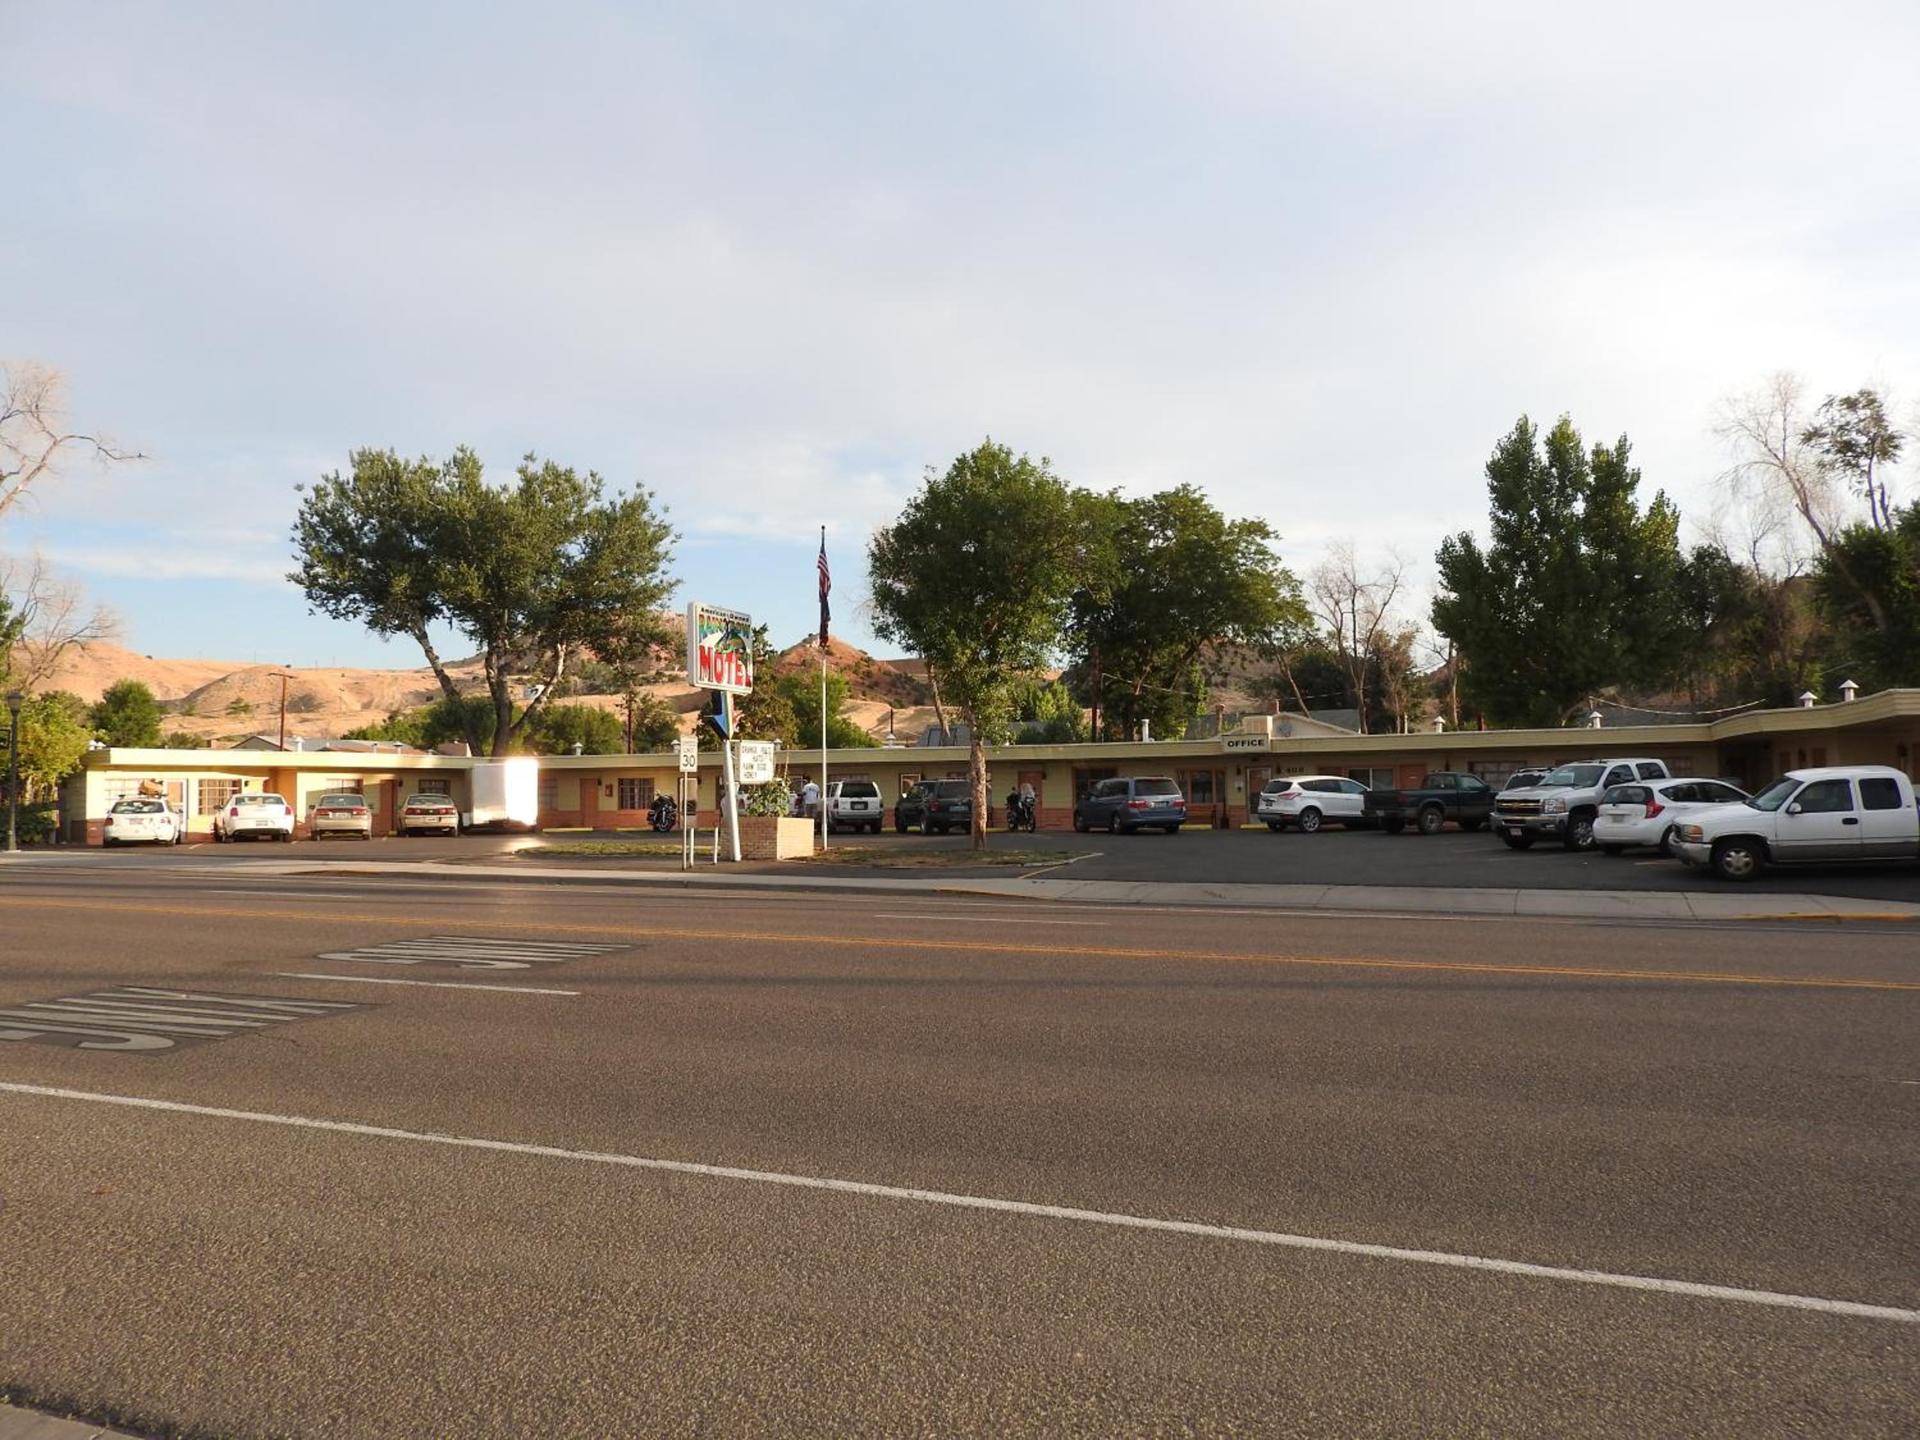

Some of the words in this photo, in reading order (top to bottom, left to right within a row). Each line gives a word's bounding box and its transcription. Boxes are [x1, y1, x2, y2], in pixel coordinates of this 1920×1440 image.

[699, 645, 752, 687] MOTEL
[1227, 739, 1264, 748] OFFICE
[682, 754, 696, 767] 30
[314, 936, 633, 970] XING
